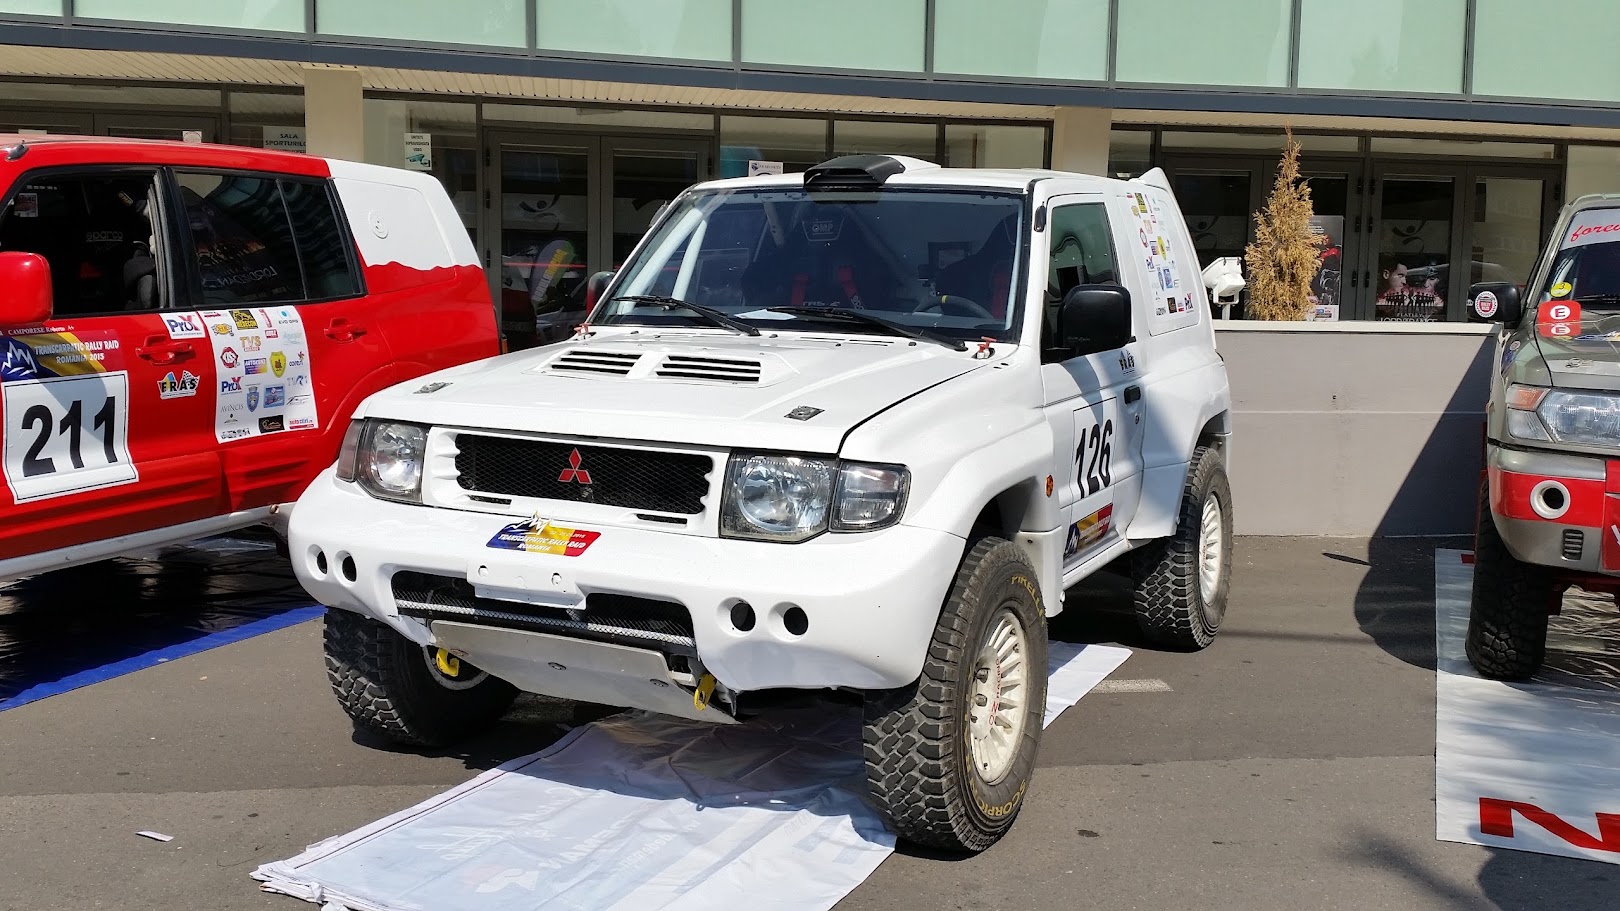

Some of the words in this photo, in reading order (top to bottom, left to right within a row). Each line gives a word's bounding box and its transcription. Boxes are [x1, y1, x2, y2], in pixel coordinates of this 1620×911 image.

[812, 223, 833, 232] OMP
[86, 230, 123, 241] sparco
[1555, 308, 1566, 317] E
[8, 327, 45, 336] CAMPORESE
[34, 343, 83, 355] TRANSCARPATIC
[85, 341, 103, 351] RALLY
[104, 340, 119, 350] RAID
[240, 336, 261, 348] TVS
[161, 379, 197, 393] FRAS
[21, 396, 118, 477] 211
[1075, 418, 1112, 500] 126
[567, 541, 586, 549] RAID
